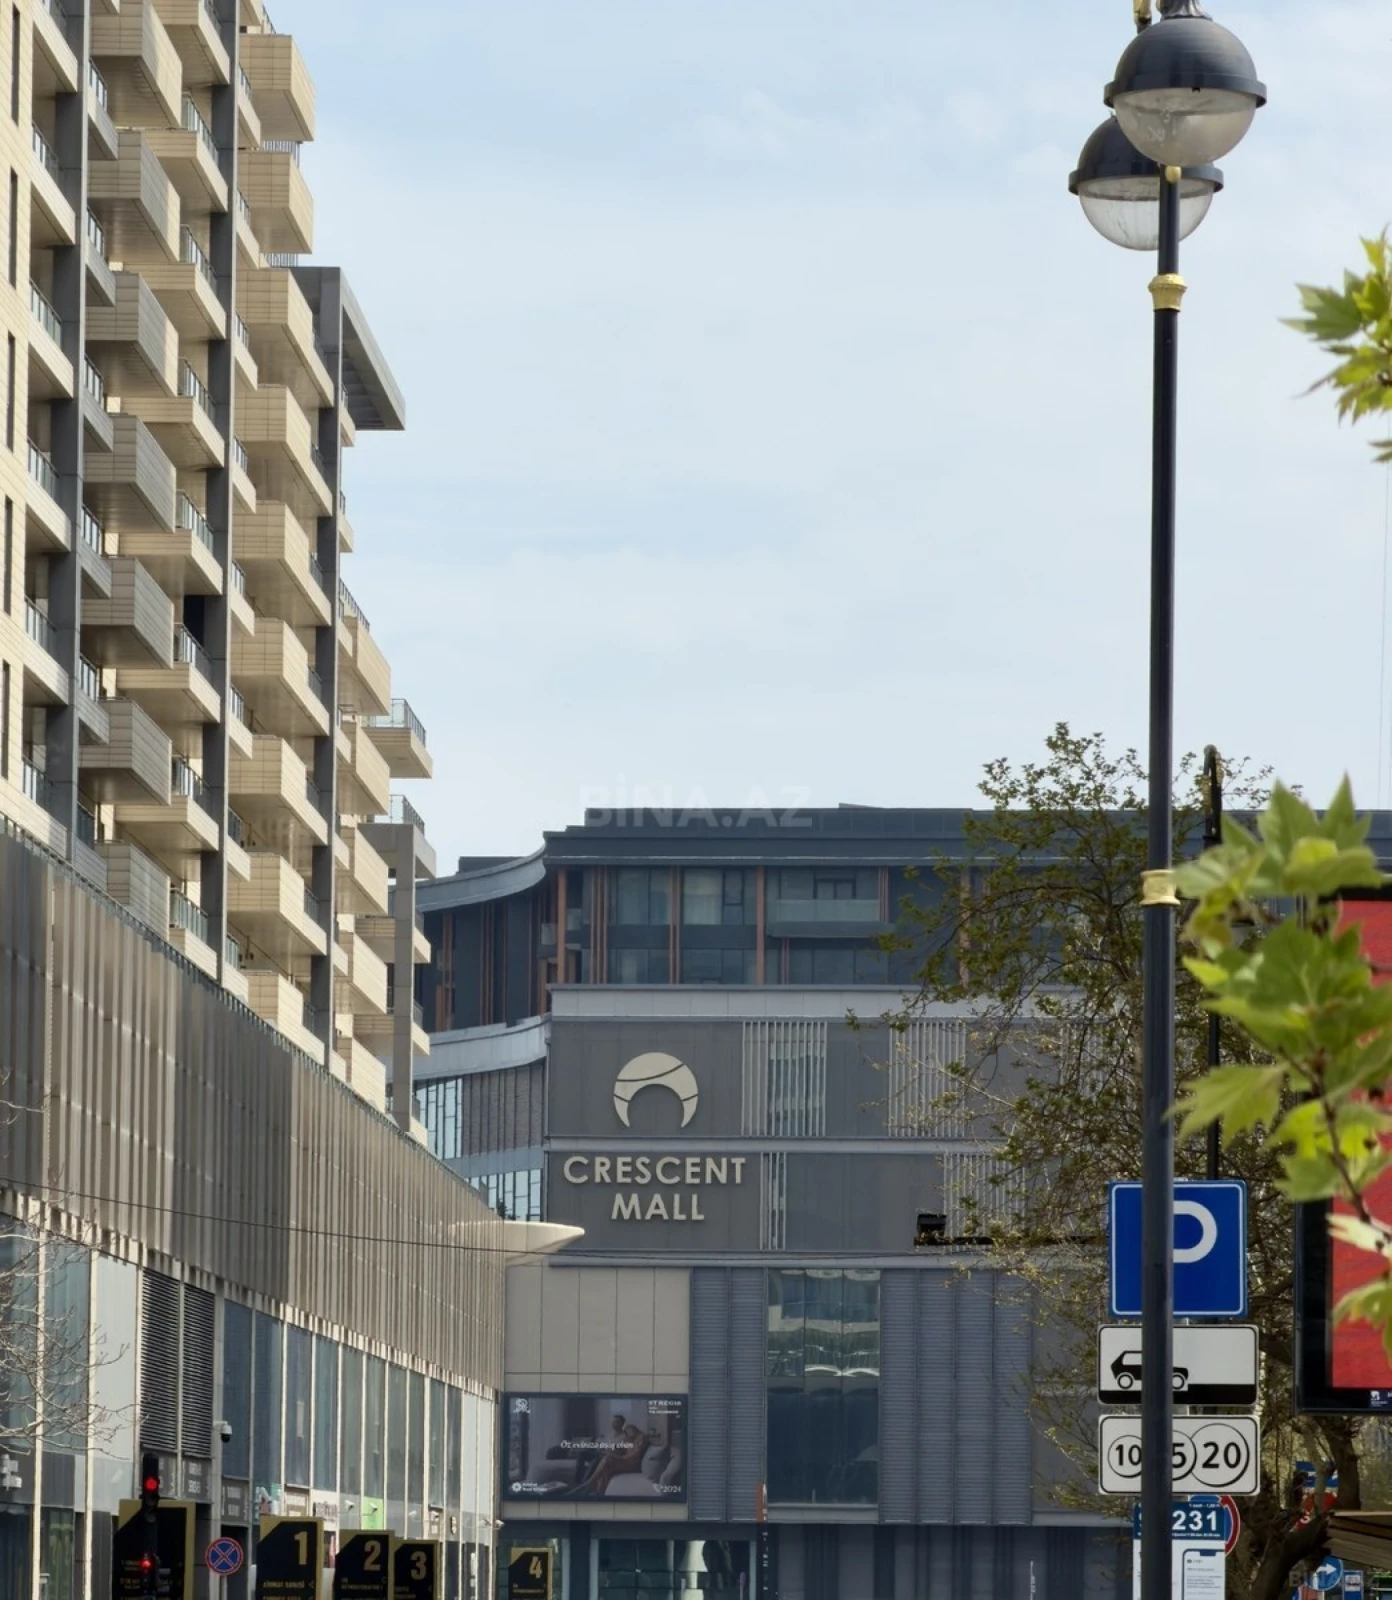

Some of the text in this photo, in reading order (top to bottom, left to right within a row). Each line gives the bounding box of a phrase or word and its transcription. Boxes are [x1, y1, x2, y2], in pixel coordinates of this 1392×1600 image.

[563, 1155, 746, 1185] CRESCENT
[611, 1192, 705, 1221] MALL
[1115, 1443, 1142, 1466] 10
[1202, 1441, 1241, 1469] 20
[293, 1531, 308, 1565] 1
[363, 1539, 381, 1572] 2
[410, 1550, 428, 1581] 3
[529, 1555, 543, 1579] 4
